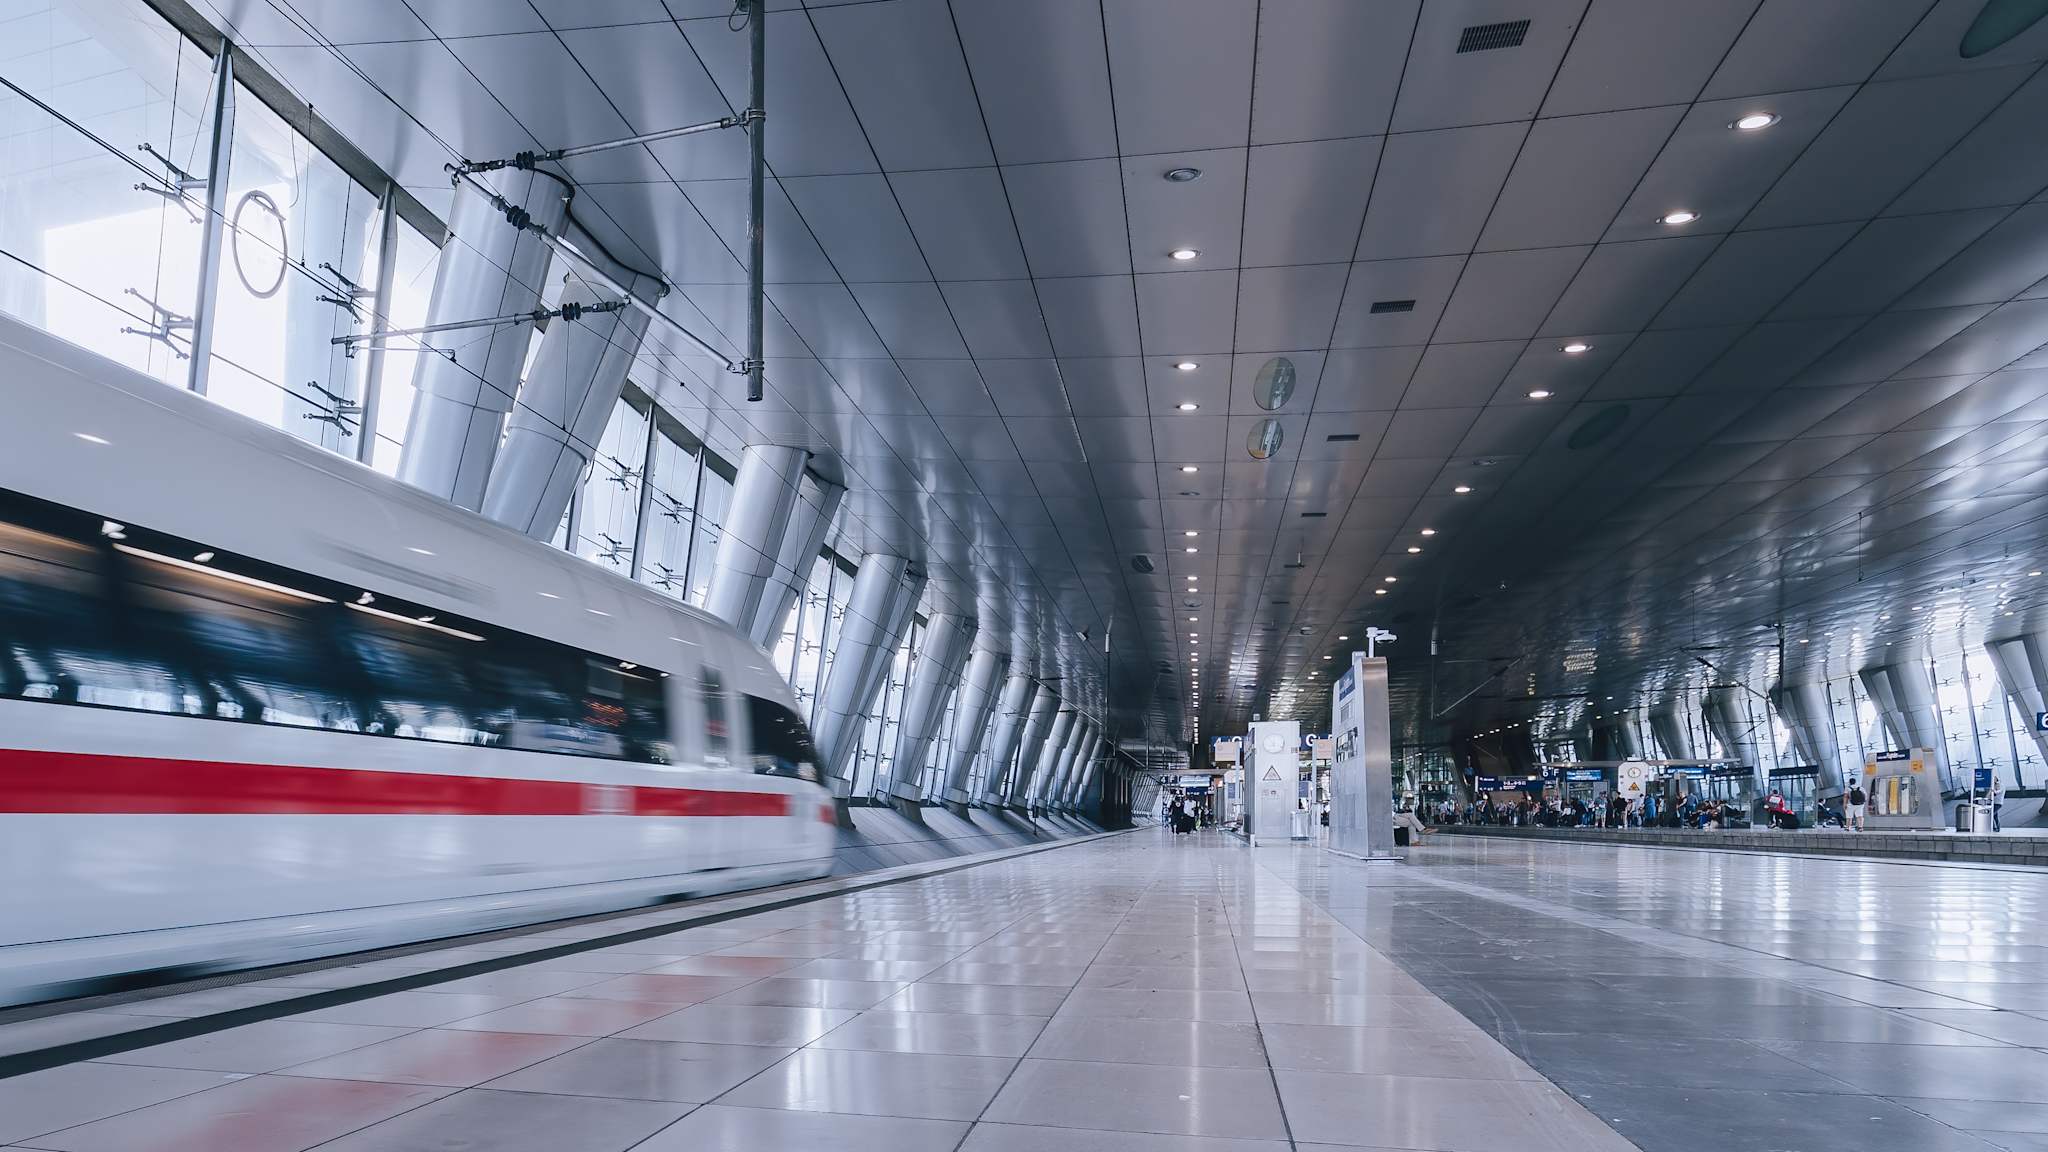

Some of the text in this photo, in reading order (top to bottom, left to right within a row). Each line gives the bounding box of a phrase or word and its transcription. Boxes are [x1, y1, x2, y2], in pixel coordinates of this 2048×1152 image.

[2041, 712, 2048, 728] 6
[1542, 769, 1549, 777] 6
[1553, 768, 1560, 777] F
